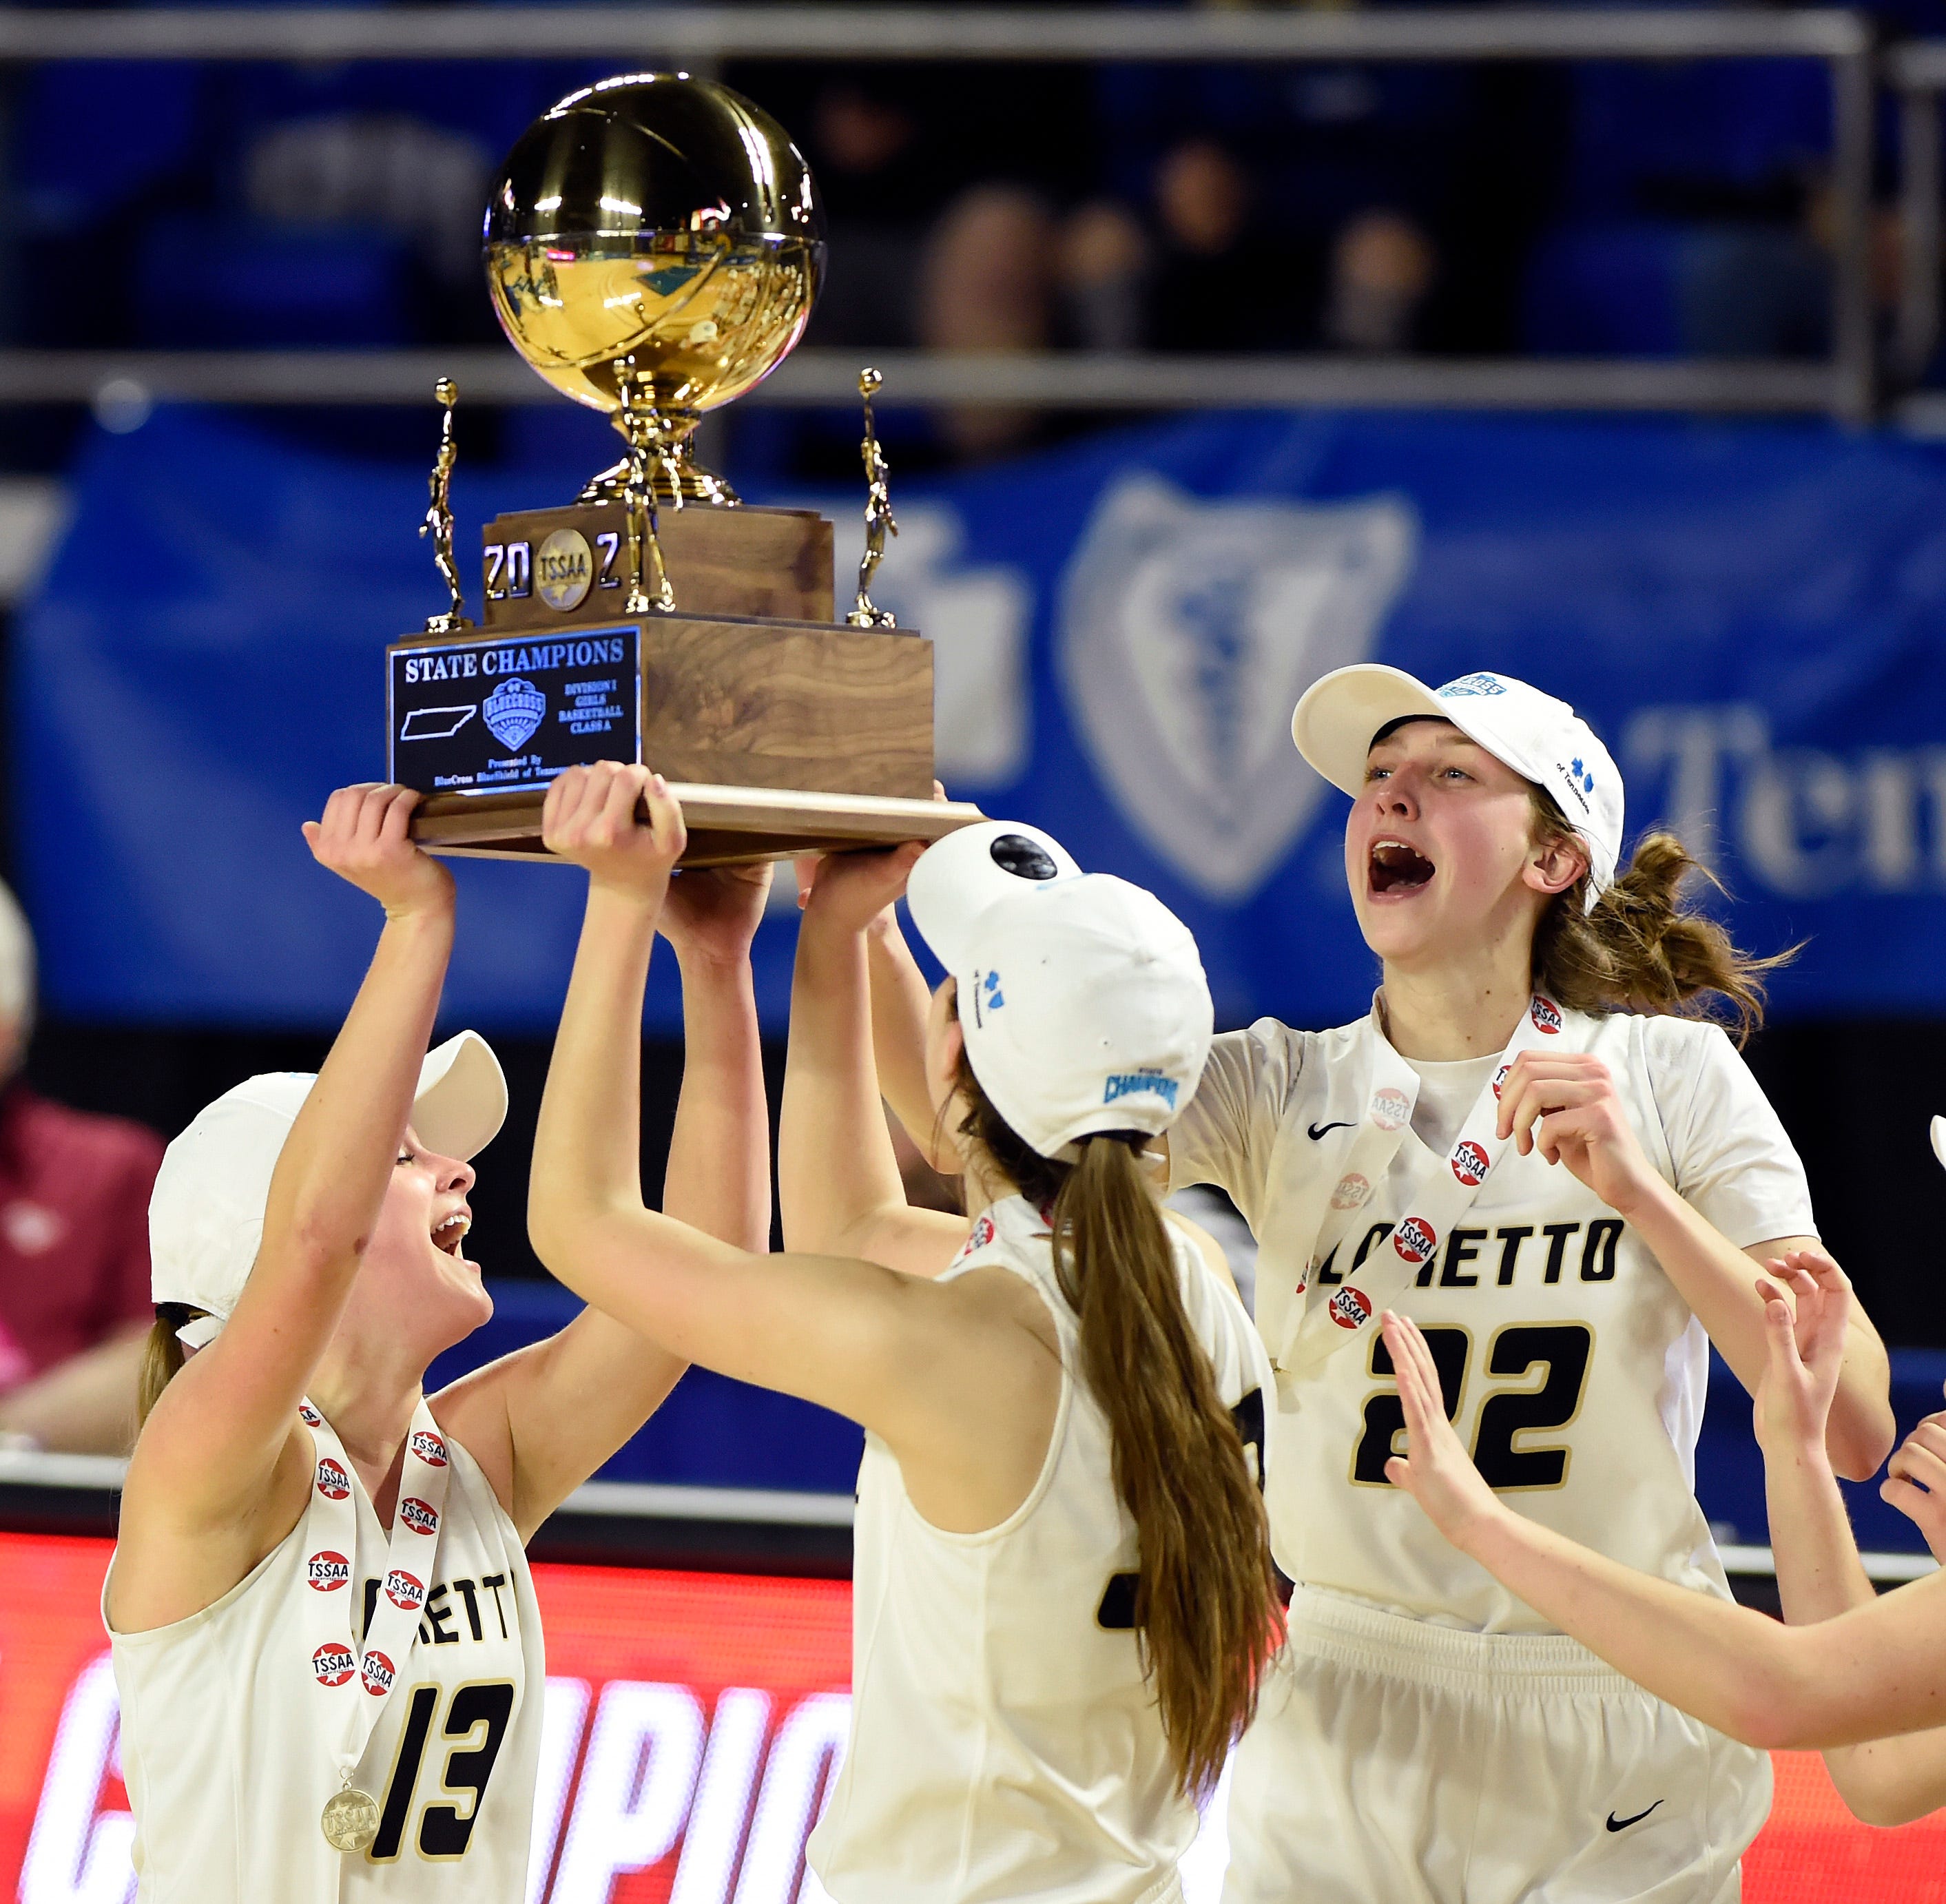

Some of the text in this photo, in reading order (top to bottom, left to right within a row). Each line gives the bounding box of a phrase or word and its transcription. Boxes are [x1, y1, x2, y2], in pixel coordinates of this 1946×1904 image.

[484, 541, 530, 599] 20
[541, 552, 586, 581] TSSAA
[405, 638, 624, 683] STATE CHAMPIONS
[558, 705, 624, 723] BASKETBALL
[570, 719, 603, 735] CLASS
[522, 767, 532, 778] of
[1532, 997, 1562, 1029] TSSAA
[1453, 1144, 1489, 1181] TSSAA
[1399, 1219, 1433, 1257] TSSAA
[1335, 1286, 1368, 1325] TSSAA
[1347, 1319, 1597, 1493] 22
[412, 1436, 448, 1462] TSSAA
[318, 1466, 351, 1489] TSSAA
[402, 1502, 437, 1529] TSSAA
[308, 1562, 349, 1577] TSSAA
[387, 1574, 423, 1602] TSSAA
[312, 1653, 355, 1675] TSSAA
[363, 1655, 393, 1688] TSSAA
[364, 1677, 517, 1865] 13
